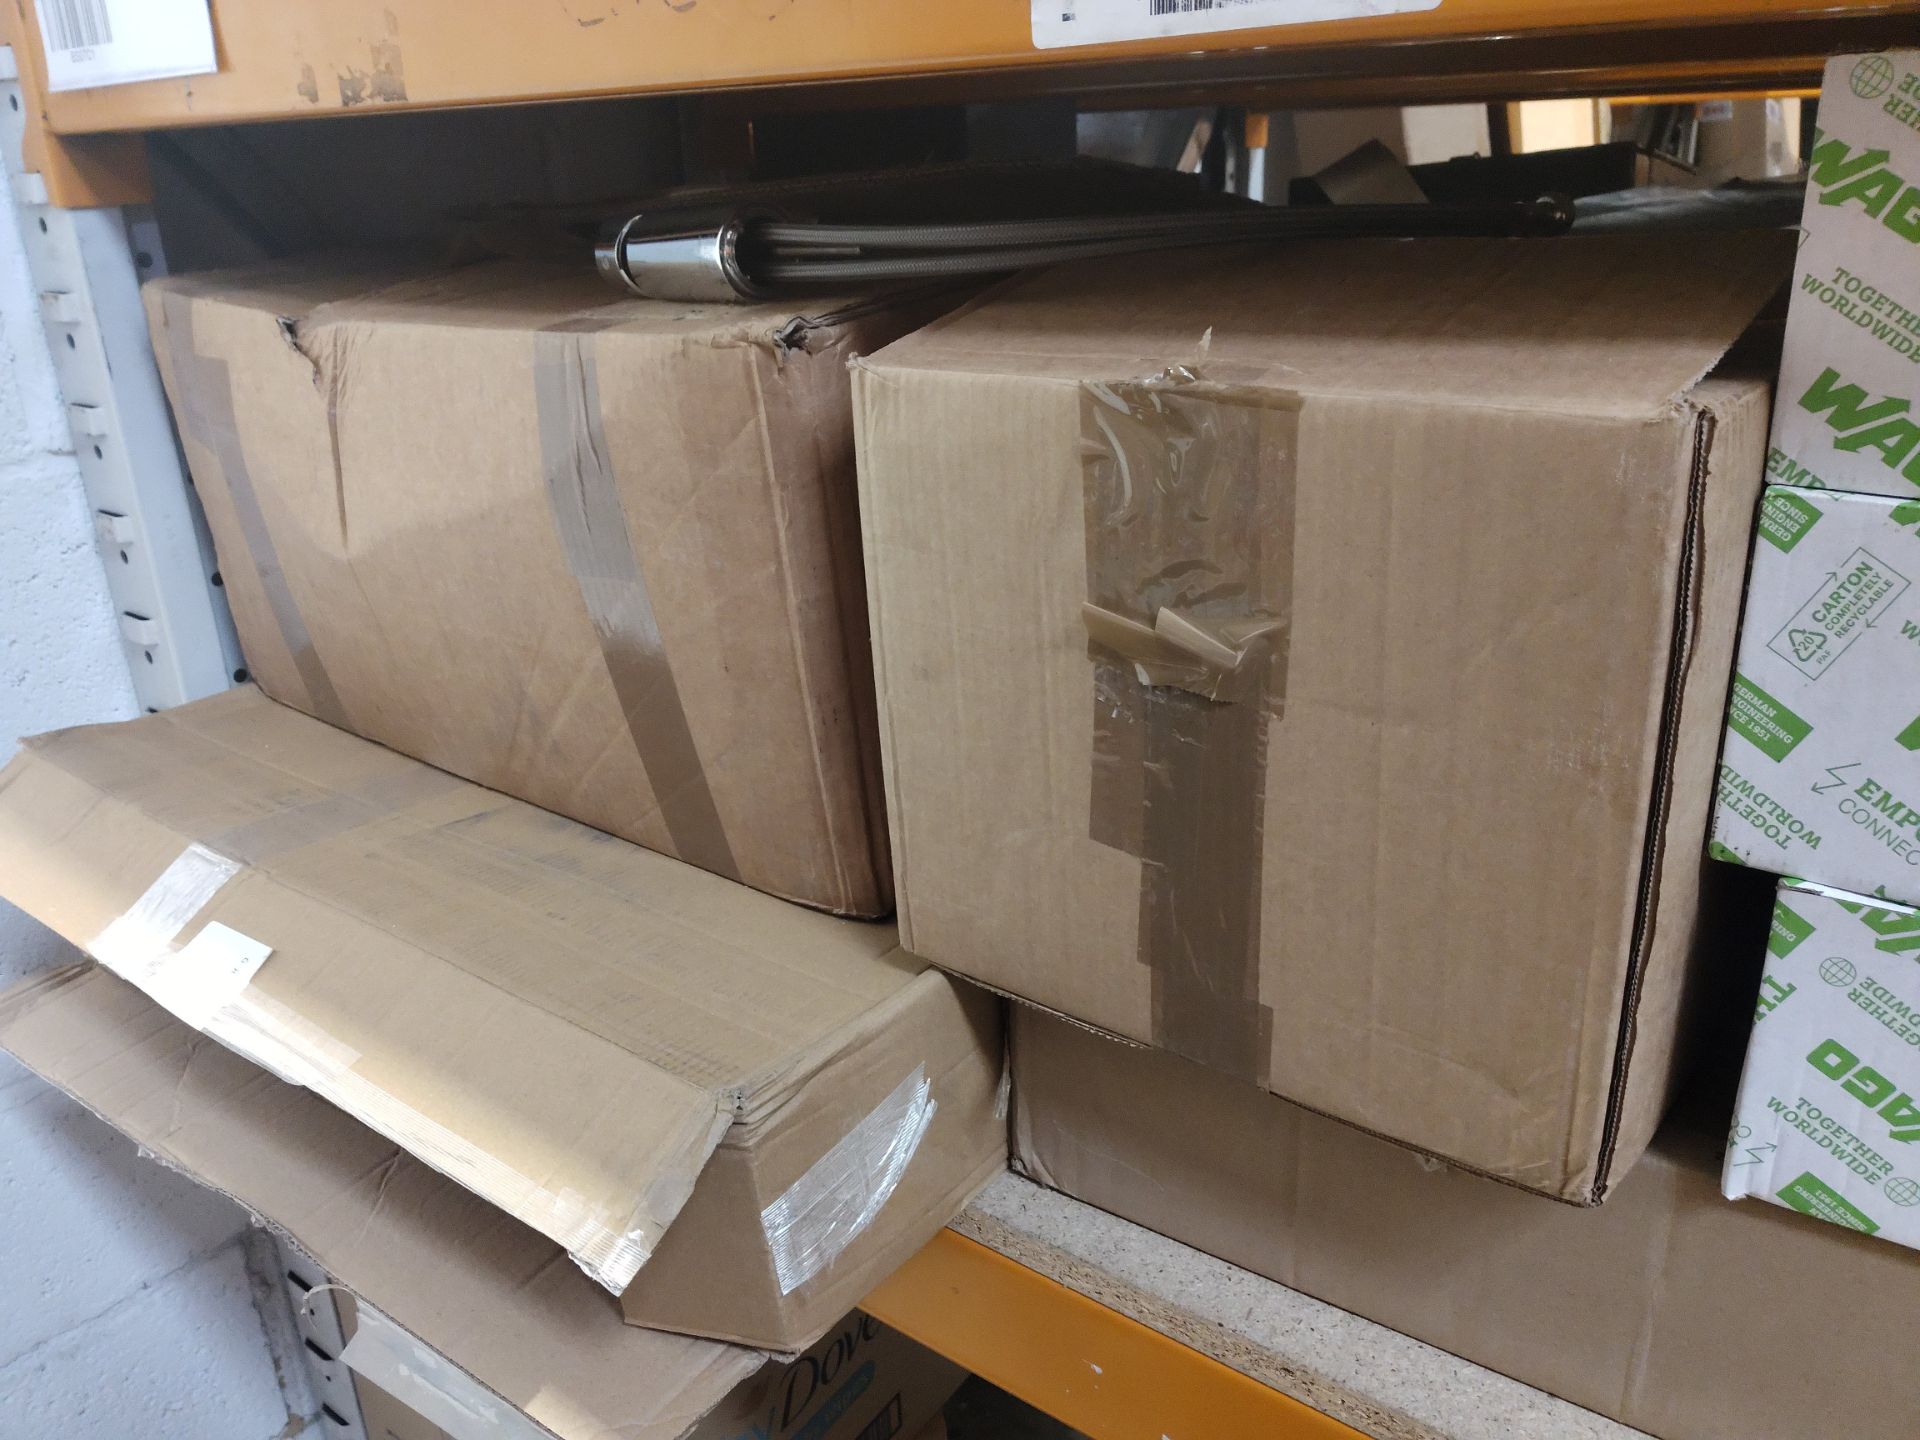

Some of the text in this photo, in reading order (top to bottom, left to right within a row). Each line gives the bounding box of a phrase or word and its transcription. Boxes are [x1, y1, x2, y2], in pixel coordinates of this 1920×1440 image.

[1773, 497, 1809, 524] SINCE
[1811, 561, 1874, 623] CARTON
[1825, 572, 1882, 631] COMPLETELY
[1834, 579, 1895, 639] RECYCLABLE
[1798, 635, 1815, 651] 20
[1733, 682, 1777, 718] GERMAN
[1747, 721, 1771, 742] 1951
[1717, 786, 1792, 850] TOGETH
[1848, 987, 1920, 1052] GETHER
[1766, 1096, 1882, 1185] WORLDWIDE
[1794, 1096, 1895, 1176] TOGETHER
